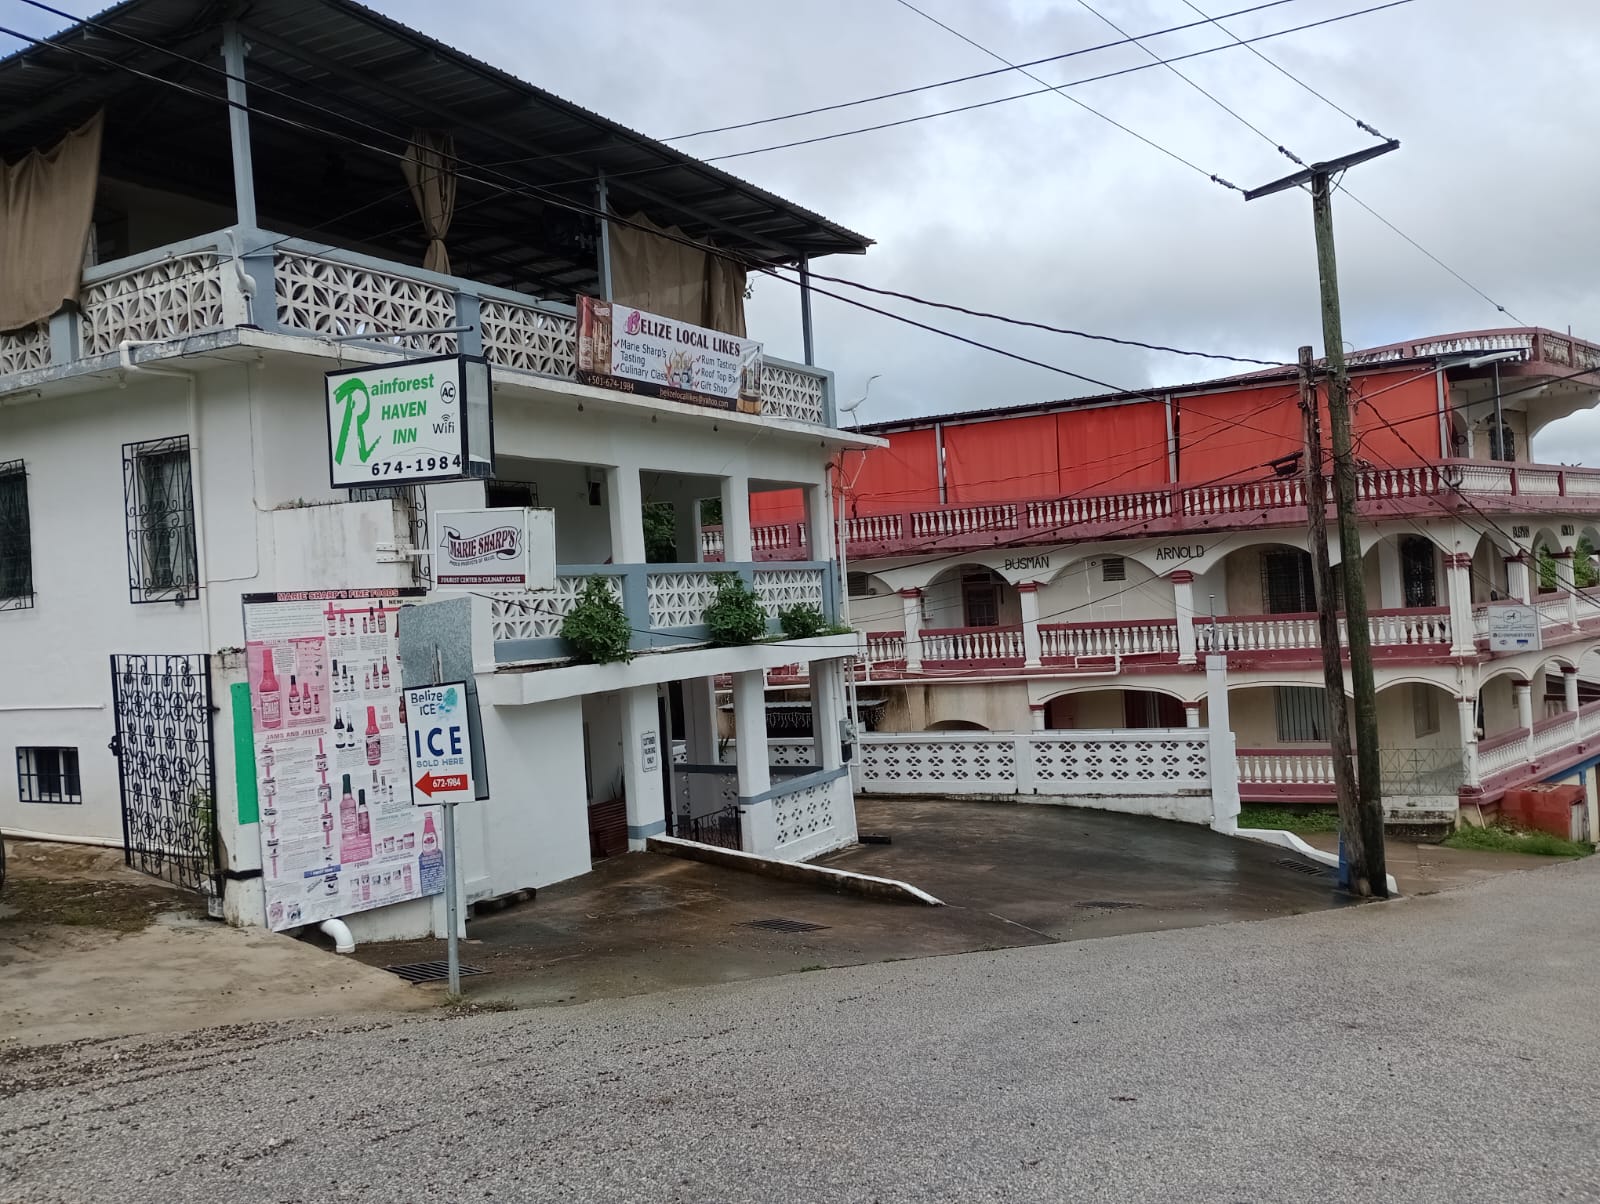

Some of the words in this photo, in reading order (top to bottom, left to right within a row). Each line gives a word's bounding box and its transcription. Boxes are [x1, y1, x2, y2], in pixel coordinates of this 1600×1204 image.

[624, 310, 672, 340] BELIZE
[676, 327, 709, 350] LOCAL
[712, 338, 740, 358] LIKES
[620, 339, 641, 353] Marie
[642, 344, 668, 359] Sharp's
[621, 351, 646, 368] Tasting
[702, 355, 715, 366] Rum
[717, 358, 737, 372] Tasting
[620, 363, 649, 380] Culinary
[650, 370, 668, 382] Class
[701, 368, 716, 379] Roof
[716, 370, 726, 382] Top
[442, 388, 454, 398] AC
[700, 381, 712, 392] Gift
[713, 382, 728, 396] Shop
[382, 400, 427, 420] HAVEN
[432, 421, 455, 434] Wifi
[393, 428, 418, 445] INN
[372, 454, 462, 476] 674-1984
[450, 540, 477, 558] MARIE
[478, 530, 516, 554] SHARP'S
[1005, 556, 1050, 570] BUSMAN
[1156, 545, 1205, 560] ARNOLD
[277, 592, 308, 602] MARIE
[308, 590, 348, 600] SHARP'S
[349, 590, 370, 599] FINE
[371, 589, 399, 598] FOODS
[410, 690, 444, 704] Belize
[420, 704, 436, 716] ICE
[266, 732, 284, 740] JAMS
[286, 730, 300, 738] AND
[414, 726, 463, 758] ICE
[416, 758, 439, 768] SOLD
[442, 757, 464, 766] HERE
[432, 775, 462, 788] 672-1984
